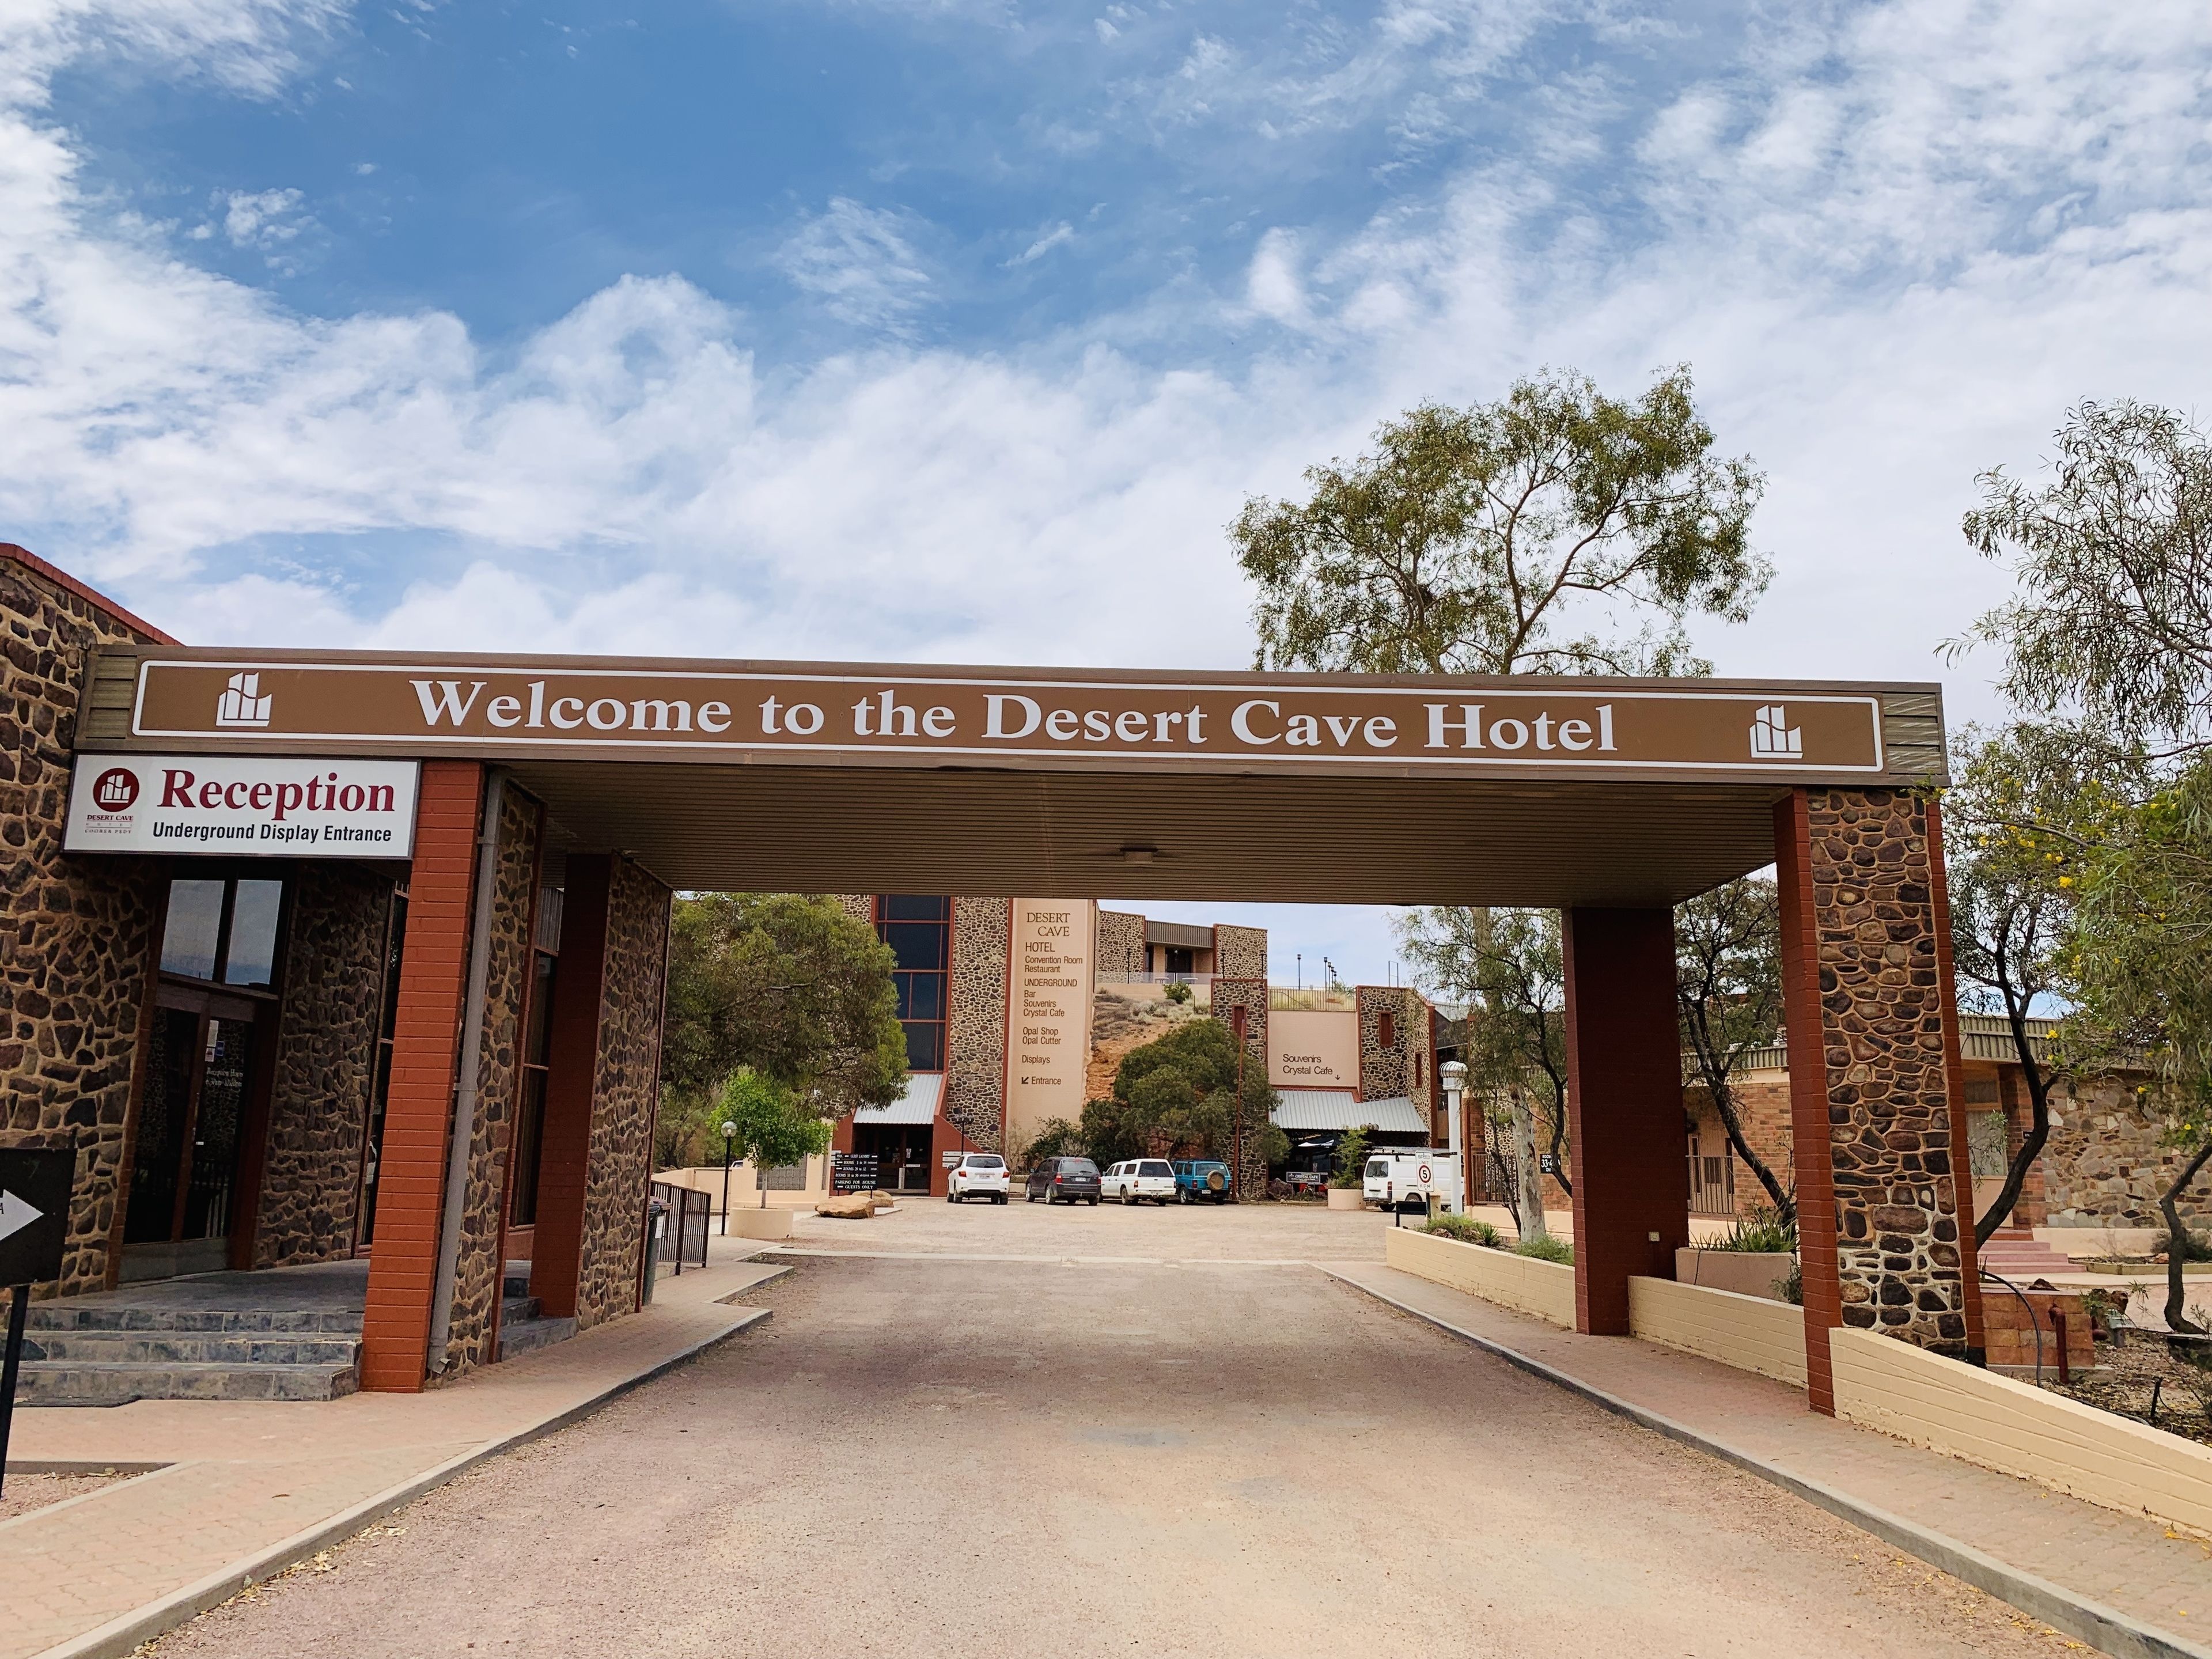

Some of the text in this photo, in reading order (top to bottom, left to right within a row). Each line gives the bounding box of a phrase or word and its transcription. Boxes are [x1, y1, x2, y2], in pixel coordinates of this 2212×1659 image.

[409, 680, 1618, 751] Welcome to the Desert Cave Hotel
[157, 769, 395, 821] Reception
[153, 821, 392, 844] Underground Display Entrance
[1026, 912, 1071, 923] DESERT
[1037, 926, 1070, 937] CAVE
[1025, 942, 1055, 952] HOTEL
[1025, 955, 1083, 964] Convention Room
[1024, 964, 1060, 973] Restaurant
[1024, 978, 1078, 987] UNDERGROUND
[1024, 990, 1036, 998] Bar
[1024, 999, 1057, 1007] Souvenirs
[1023, 1008, 1065, 1018] Crystal Cafe
[1022, 1027, 1059, 1037] Opal Shop
[1022, 1036, 1061, 1046] Opal Cutter
[1022, 1055, 1051, 1065] Displays
[1282, 1054, 1322, 1063] Souvenirs
[1282, 1065, 1334, 1075] Crystal Cafe
[1031, 1076, 1062, 1085] Entrance
[1422, 1169, 1427, 1179] 5
